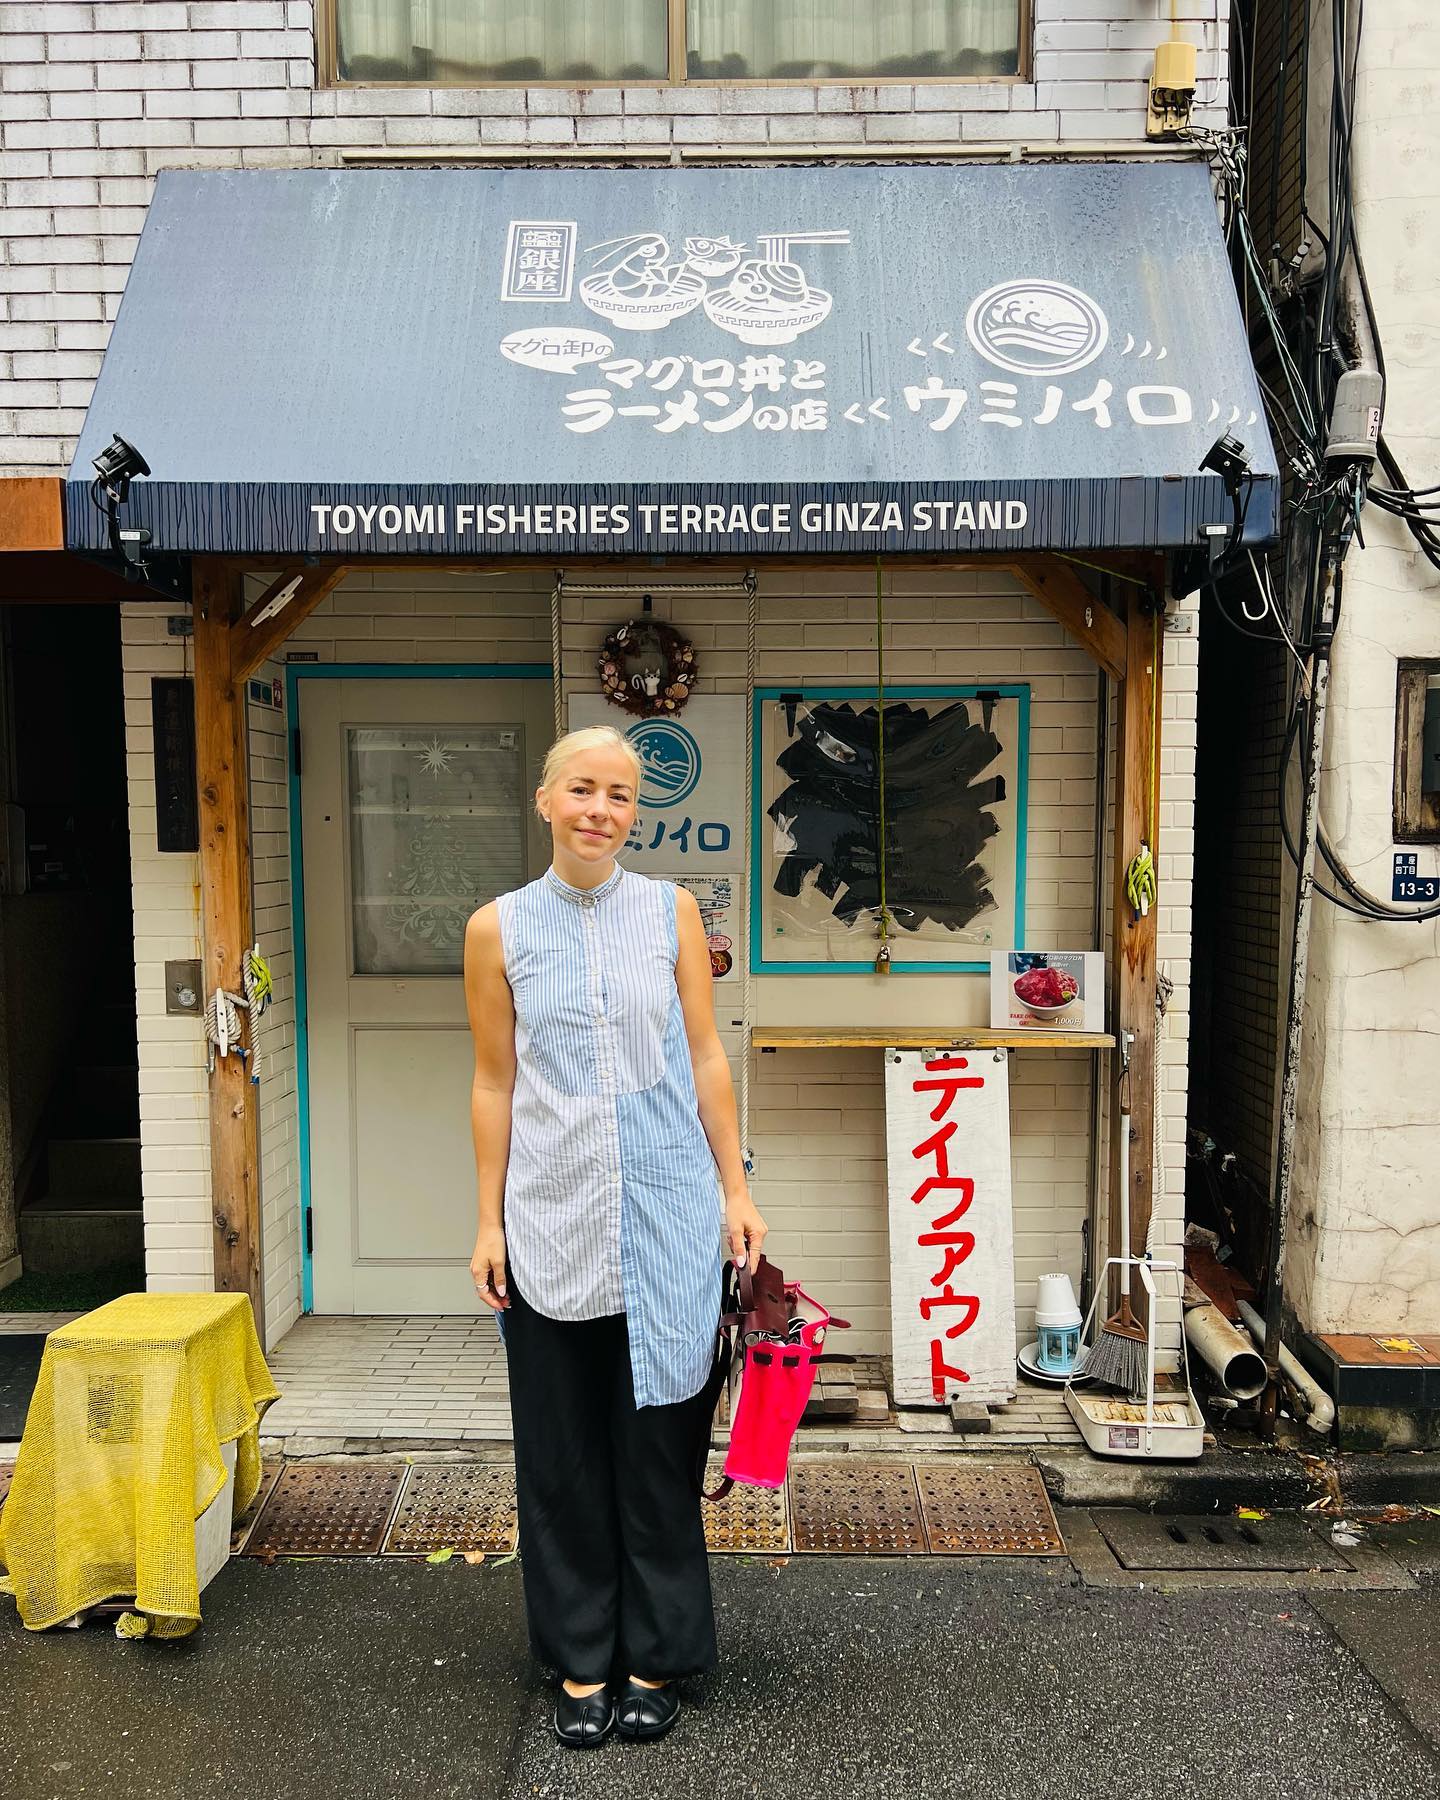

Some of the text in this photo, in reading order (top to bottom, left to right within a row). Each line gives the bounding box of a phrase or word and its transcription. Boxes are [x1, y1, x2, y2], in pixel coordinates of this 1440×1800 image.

[501, 337, 614, 358] マグロ卸の
[598, 353, 827, 391] マグロ丼と
[560, 388, 829, 434] ラーメンの店
[903, 376, 1193, 431] ウミノイロ
[310, 500, 1029, 534] TOYOMI FISHERIES TERRACE GINZA STAND
[1399, 882, 1435, 896] 13-3
[911, 1056, 985, 1402] テイクアウト
